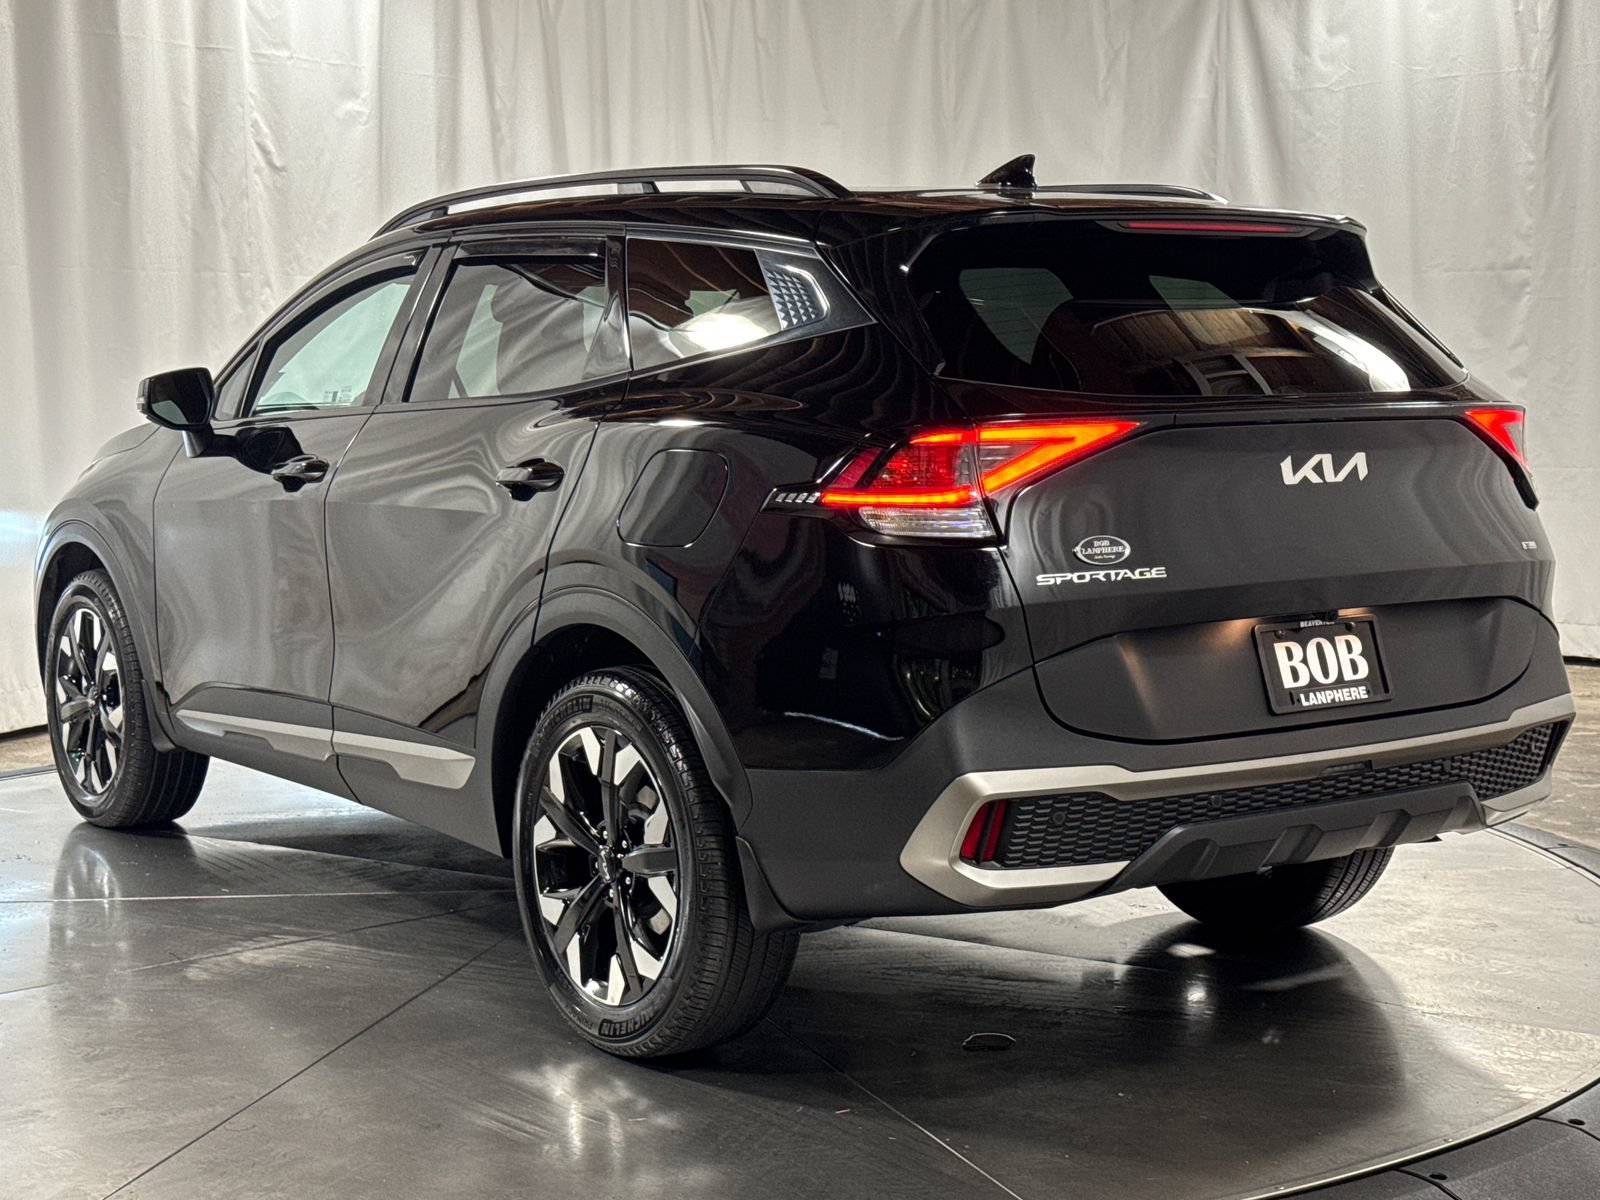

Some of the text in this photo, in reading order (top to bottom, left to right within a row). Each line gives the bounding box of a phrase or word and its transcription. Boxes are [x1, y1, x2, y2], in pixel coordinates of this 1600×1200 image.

[1082, 546, 1125, 555] LANPHERE
[1036, 567, 1167, 586] SPORTAGE
[1273, 634, 1369, 689] BOB
[1300, 686, 1369, 706] LANPHERE
[600, 1006, 656, 1036] MICHELIN
